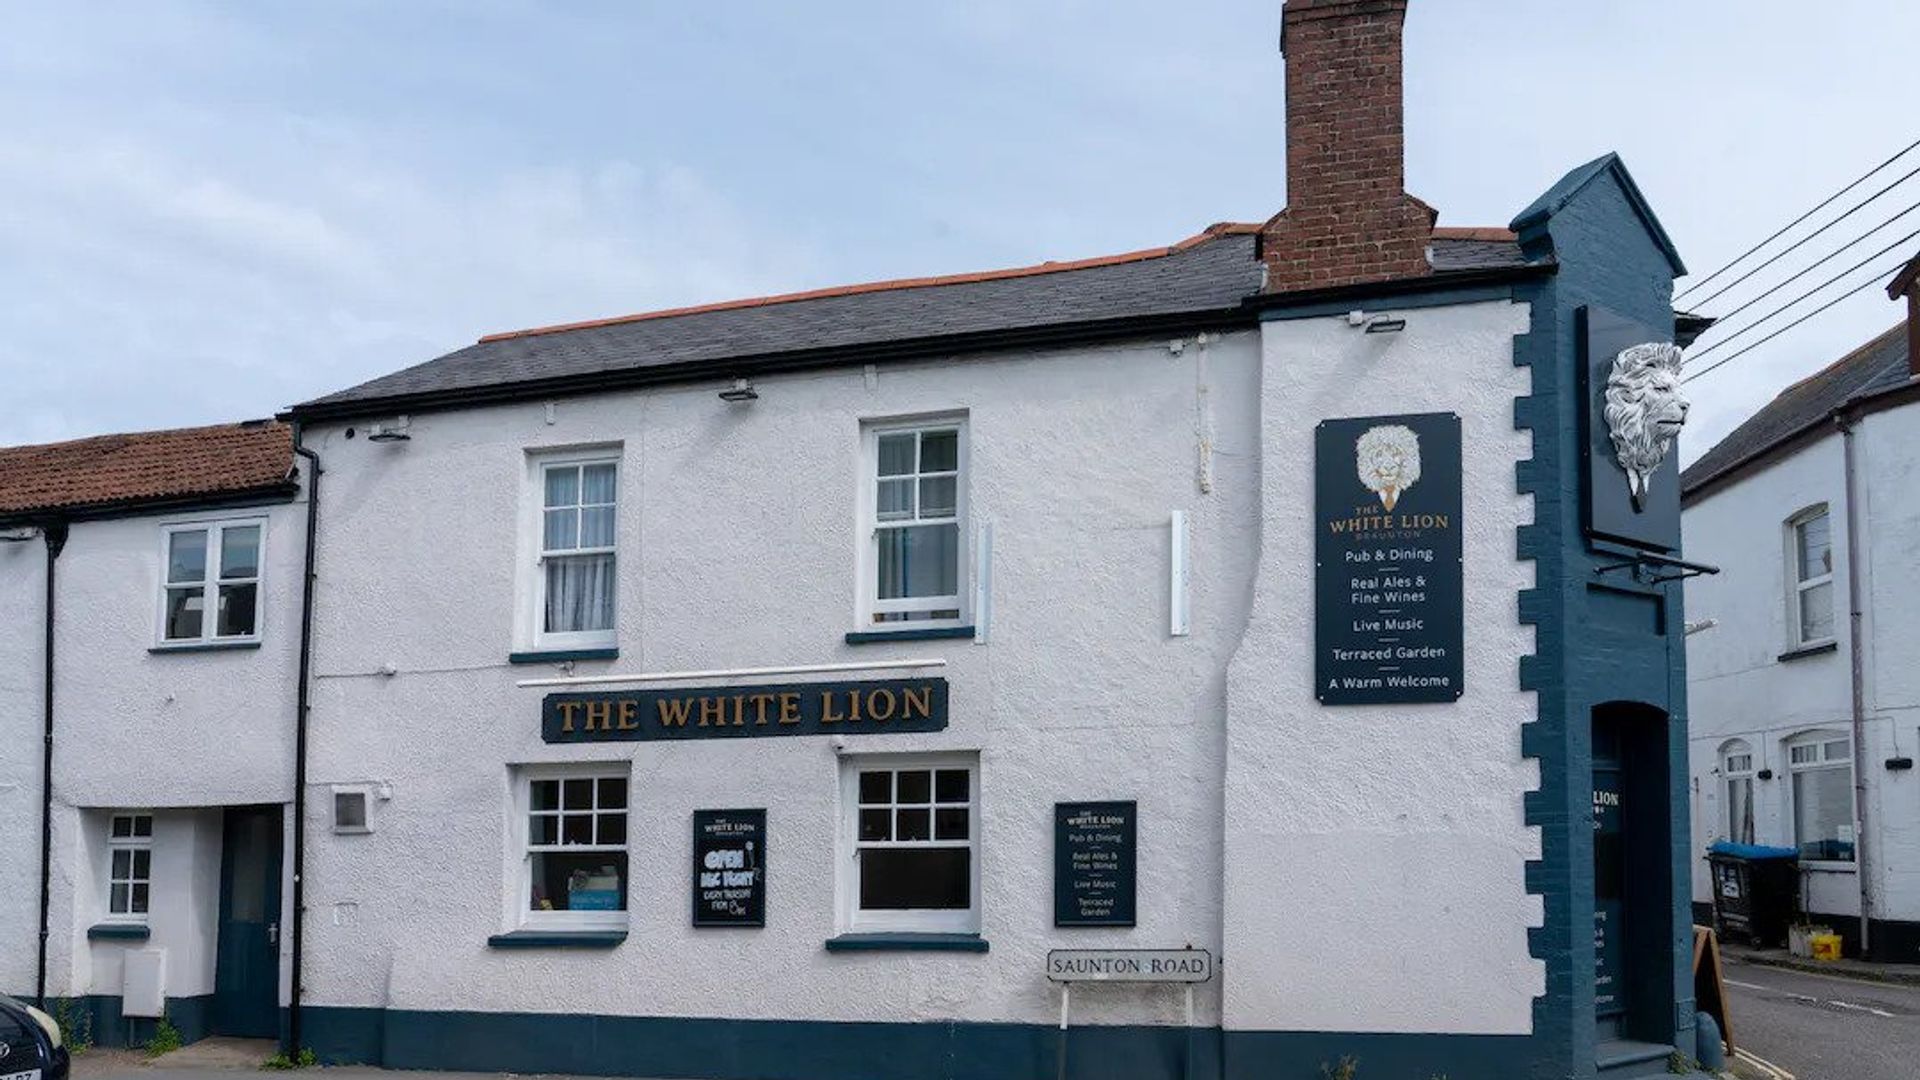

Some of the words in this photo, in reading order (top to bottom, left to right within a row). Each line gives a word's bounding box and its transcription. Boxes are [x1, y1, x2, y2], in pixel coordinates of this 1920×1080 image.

[1355, 506, 1379, 516] THE
[1330, 514, 1394, 533] WHITE
[1401, 514, 1449, 529] LION
[1346, 550, 1371, 562] Pub
[1375, 549, 1386, 561] &
[1390, 548, 1434, 562] Dining
[1351, 578, 1378, 590] Real
[1383, 576, 1411, 588] Ales
[1416, 576, 1426, 587] &
[1351, 592, 1380, 604] Fine
[1385, 591, 1425, 603] Wines
[1353, 619, 1380, 632] Live
[1385, 618, 1424, 631] Music
[1333, 648, 1392, 661] Terraced
[1396, 646, 1446, 659] Garden
[1329, 679, 1339, 689] A
[1343, 678, 1382, 689] Warm
[1387, 675, 1449, 688] Welcome
[556, 699, 640, 732] THE
[658, 692, 801, 727] WHITE
[820, 687, 933, 722] LION
[1593, 791, 1619, 805] LION
[1067, 816, 1099, 825] WHITE
[1100, 815, 1124, 824] LION
[704, 824, 733, 833] WHITE
[734, 823, 755, 832] LION
[1069, 834, 1085, 843] Pub
[1087, 834, 1094, 842] &
[1095, 833, 1121, 843] Dining
[704, 849, 744, 869] OPEN
[1072, 852, 1090, 860] Real
[1091, 852, 1109, 860] Ales
[1111, 852, 1118, 860] &
[1073, 862, 1091, 870] Fine
[1093, 862, 1118, 870] Wines
[1074, 881, 1091, 889] Live
[1093, 881, 1117, 889] Music
[1078, 898, 1114, 906] Terraced
[1080, 907, 1110, 916] Garden
[1054, 958, 1140, 973] SAUNTON
[1151, 958, 1204, 973] ROAD
